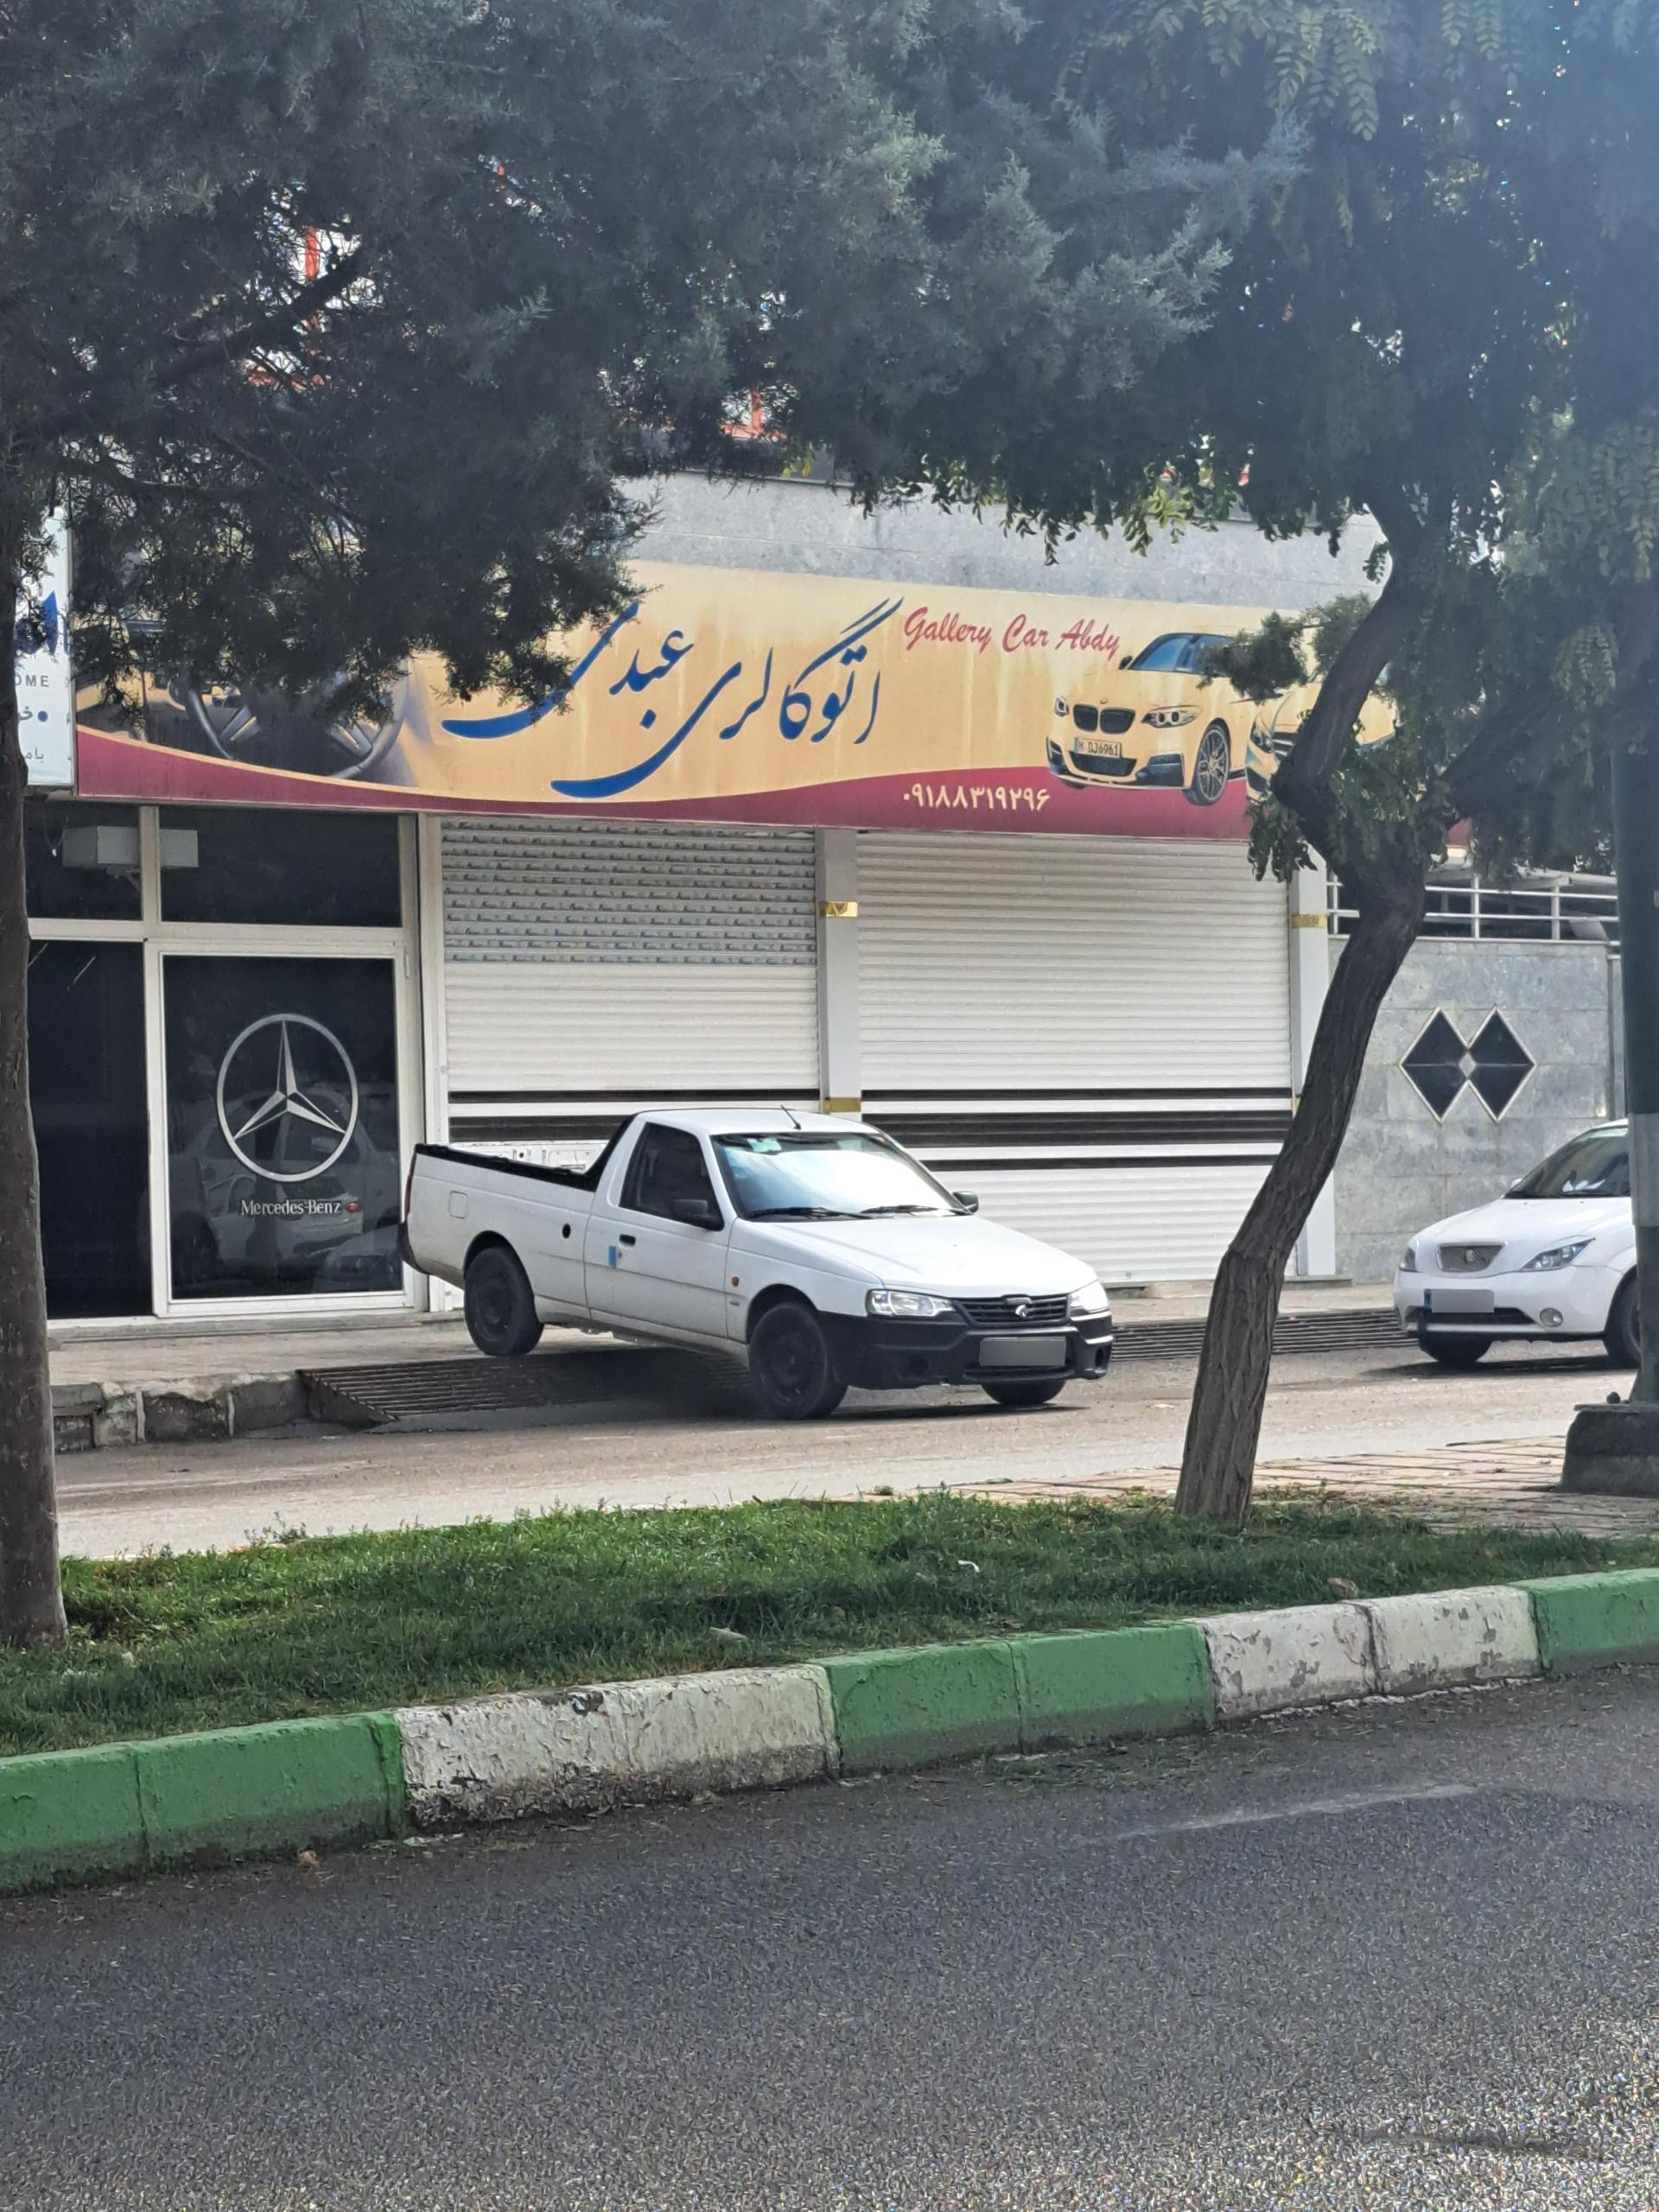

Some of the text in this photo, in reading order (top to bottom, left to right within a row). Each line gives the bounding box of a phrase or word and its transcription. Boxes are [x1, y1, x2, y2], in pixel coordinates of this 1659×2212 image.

[904, 606, 1121, 661] Gallery Car Abdy
[241, 1198, 341, 1216] Mercedes-Benz
